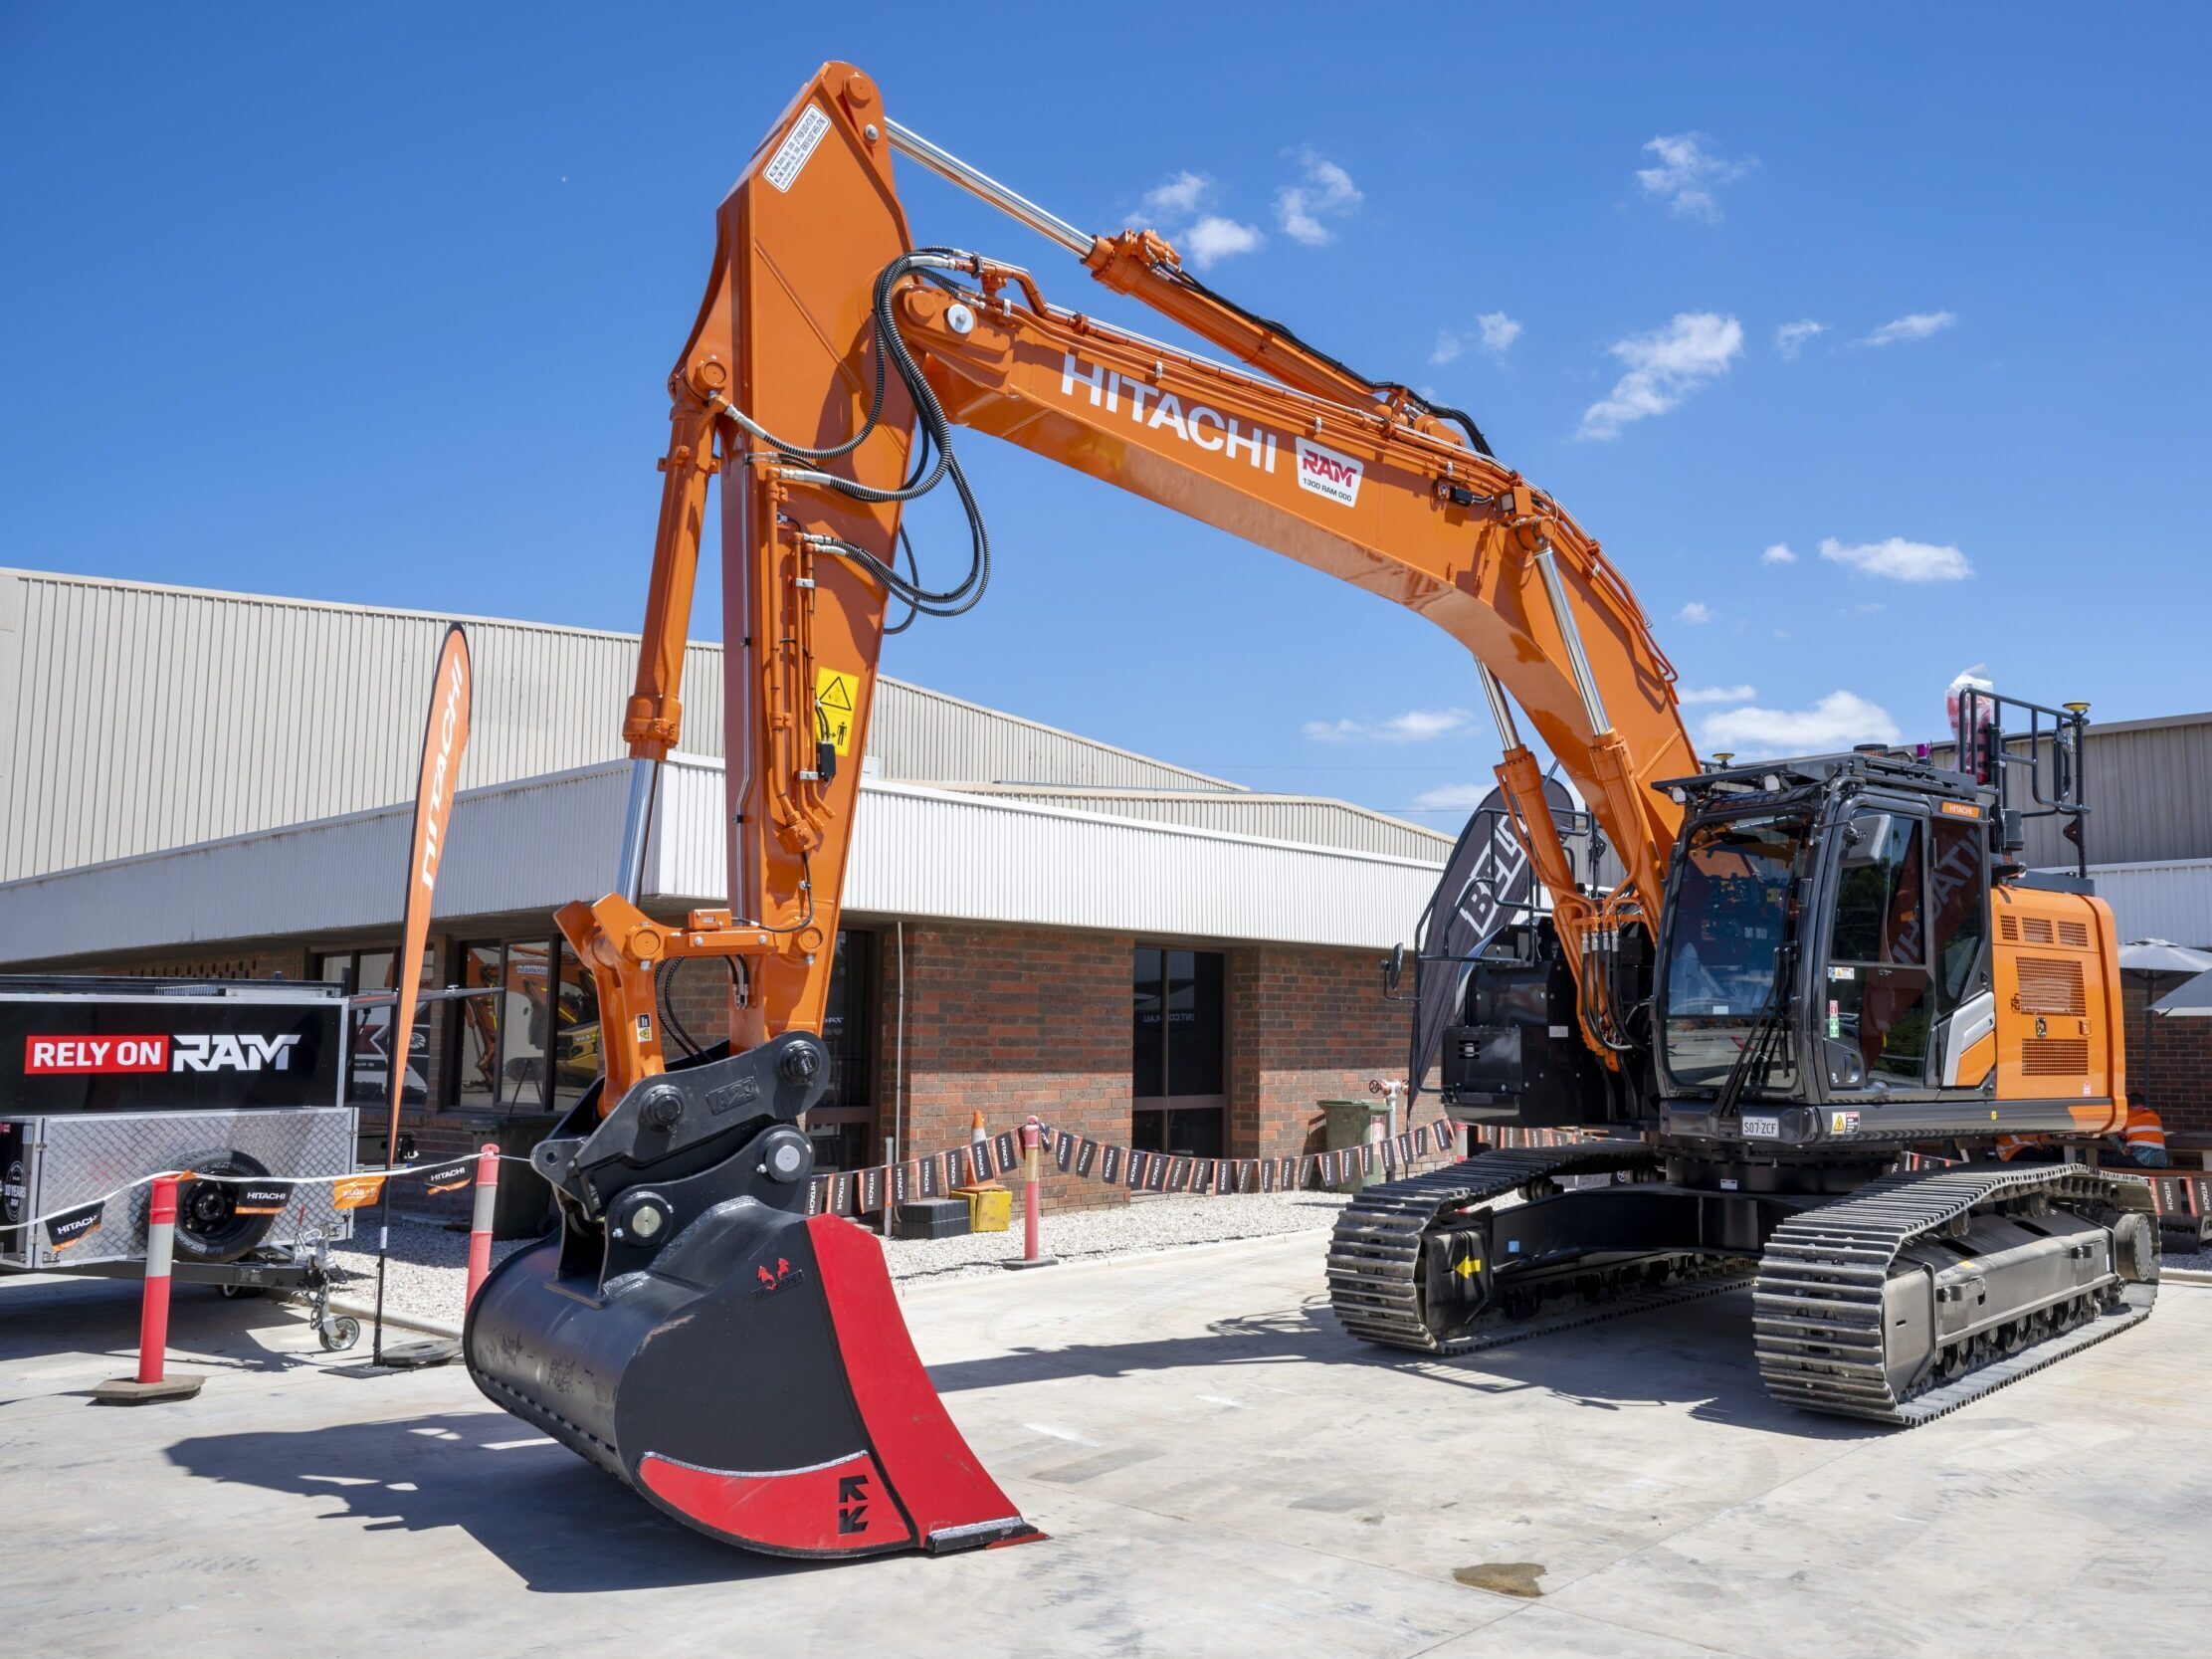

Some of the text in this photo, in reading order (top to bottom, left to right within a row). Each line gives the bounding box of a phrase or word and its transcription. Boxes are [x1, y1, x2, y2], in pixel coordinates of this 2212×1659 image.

[1061, 351, 1277, 474] HITACHI
[1303, 448, 1358, 489] RAM
[1303, 478, 1352, 502] 1300 RAM 000
[422, 652, 463, 891] HITACHI
[1949, 804, 1973, 815] HITACHI
[33, 1034, 302, 1073] RELY ON RAM
[976, 1146, 985, 1176] HITACHI
[1000, 1138, 1009, 1167] HITACHI
[1079, 1143, 1091, 1171] HITACHI
[1105, 1149, 1114, 1178] HITACHI
[430, 1166, 466, 1181] HITACHI
[1129, 1154, 1138, 1182] HITACHI
[1151, 1158, 1161, 1186] HITACHI
[1171, 1160, 1182, 1187] HITACHI
[1195, 1162, 1205, 1189] HITACHI
[837, 1177, 846, 1210] HITACHI
[2163, 1182, 2174, 1210] HITACHI
[2200, 1182, 2211, 1211] HITACHI
[57, 1214, 98, 1235] HITACH
